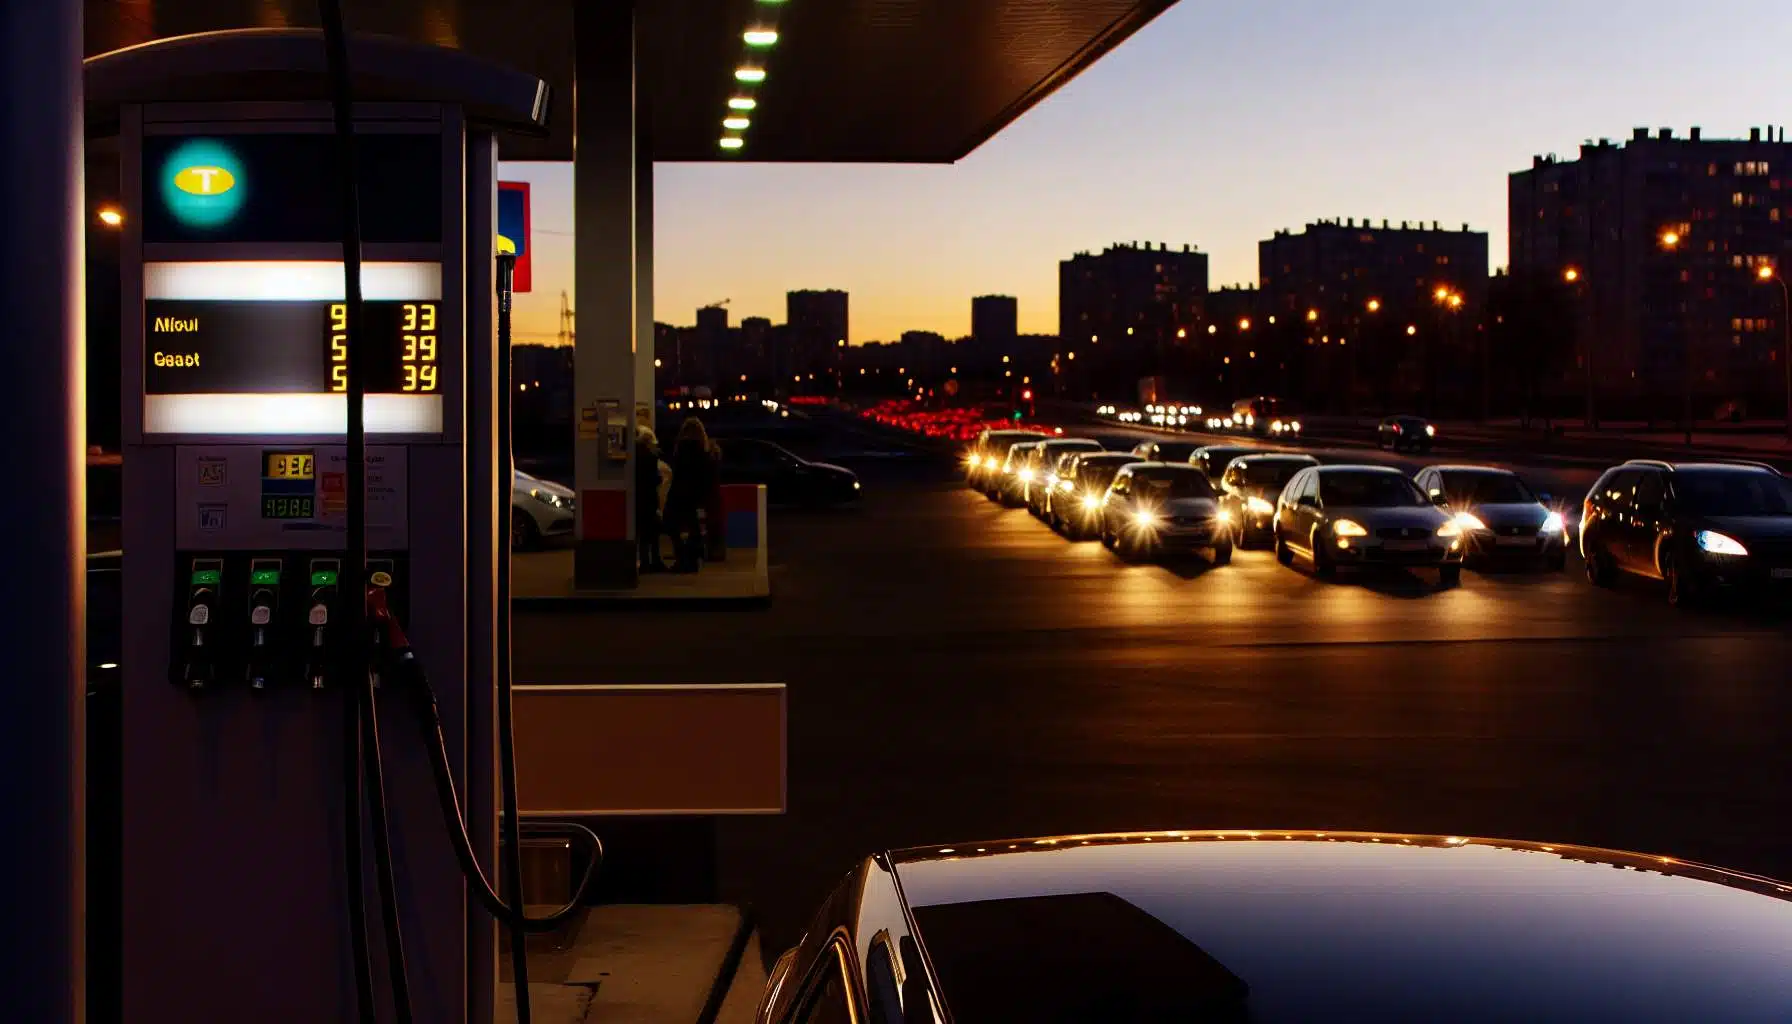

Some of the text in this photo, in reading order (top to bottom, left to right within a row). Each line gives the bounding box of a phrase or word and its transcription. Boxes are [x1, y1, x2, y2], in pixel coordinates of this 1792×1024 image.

[192, 169, 218, 193] T
[402, 304, 436, 331] 33
[332, 335, 437, 361] 5 39
[332, 365, 437, 391] 5 39
